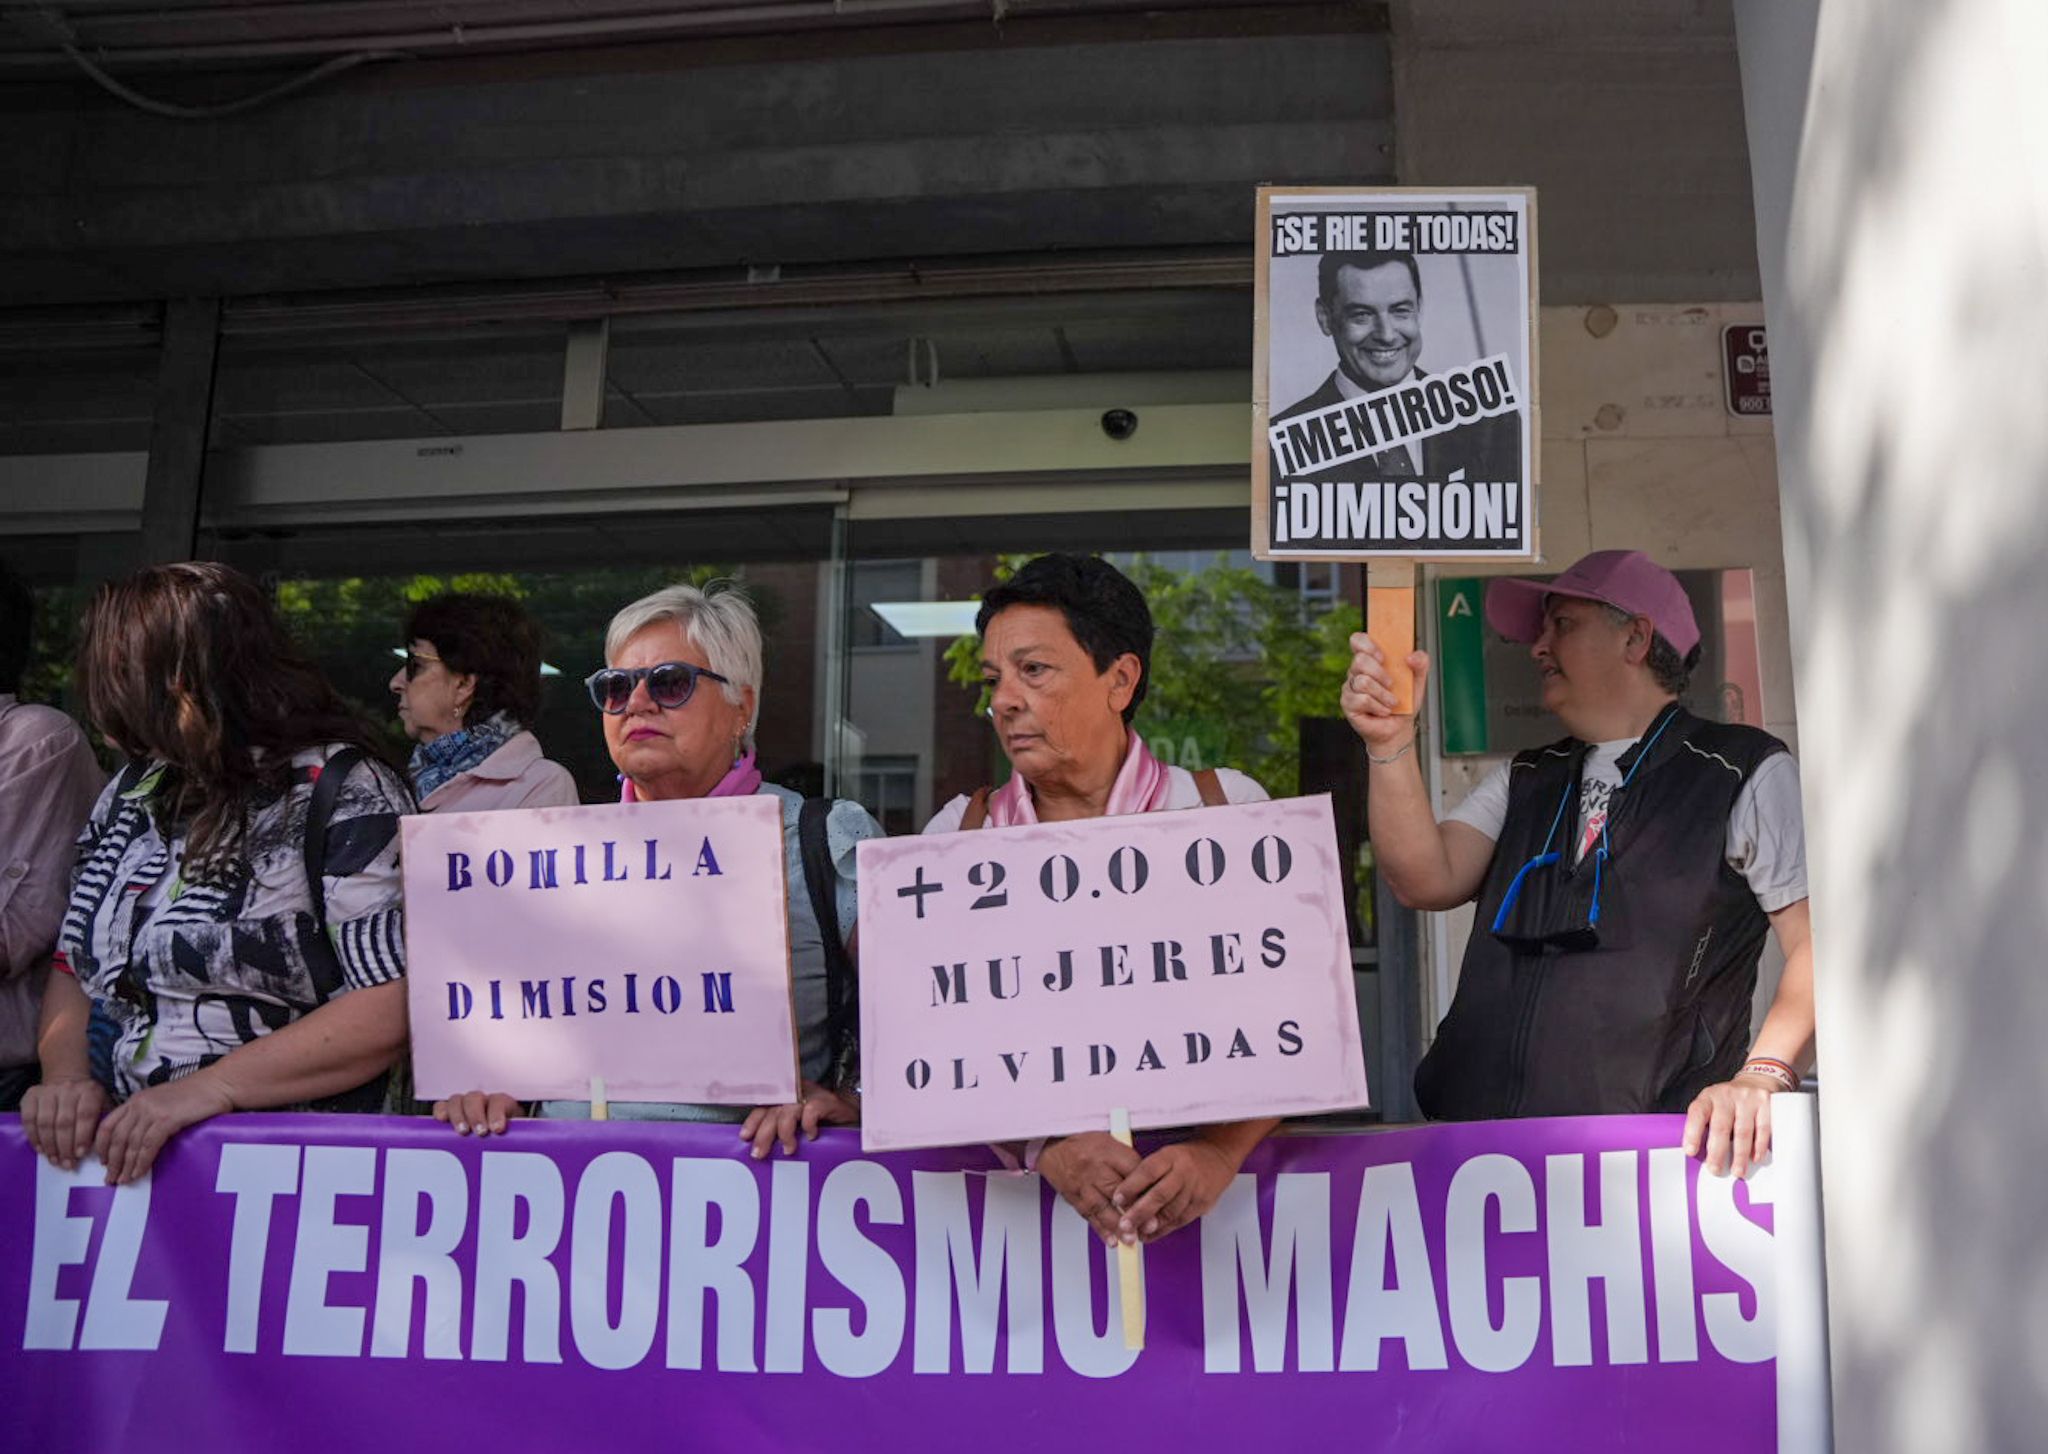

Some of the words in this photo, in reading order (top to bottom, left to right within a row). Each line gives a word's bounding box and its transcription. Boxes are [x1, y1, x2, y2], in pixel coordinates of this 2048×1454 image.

[1276, 215, 1318, 255] ¡SE
[1326, 214, 1368, 251] RIE
[1375, 214, 1411, 251] DE
[1416, 214, 1515, 251] TODAS!
[1275, 360, 1516, 474] ¡MENTIROSO!
[1275, 468, 1519, 542] ¡DIMISIÓN!
[446, 836, 723, 891] BONILLA
[897, 834, 1293, 918] +20.000
[446, 971, 736, 1021] DIMISION
[930, 927, 1287, 1007] MUJERES
[905, 1020, 1304, 1091] OLVIDADAS
[23, 1152, 169, 1351] EL
[215, 1143, 1146, 1378] TERRORISMO
[1203, 1146, 1778, 1373] MACHIS
